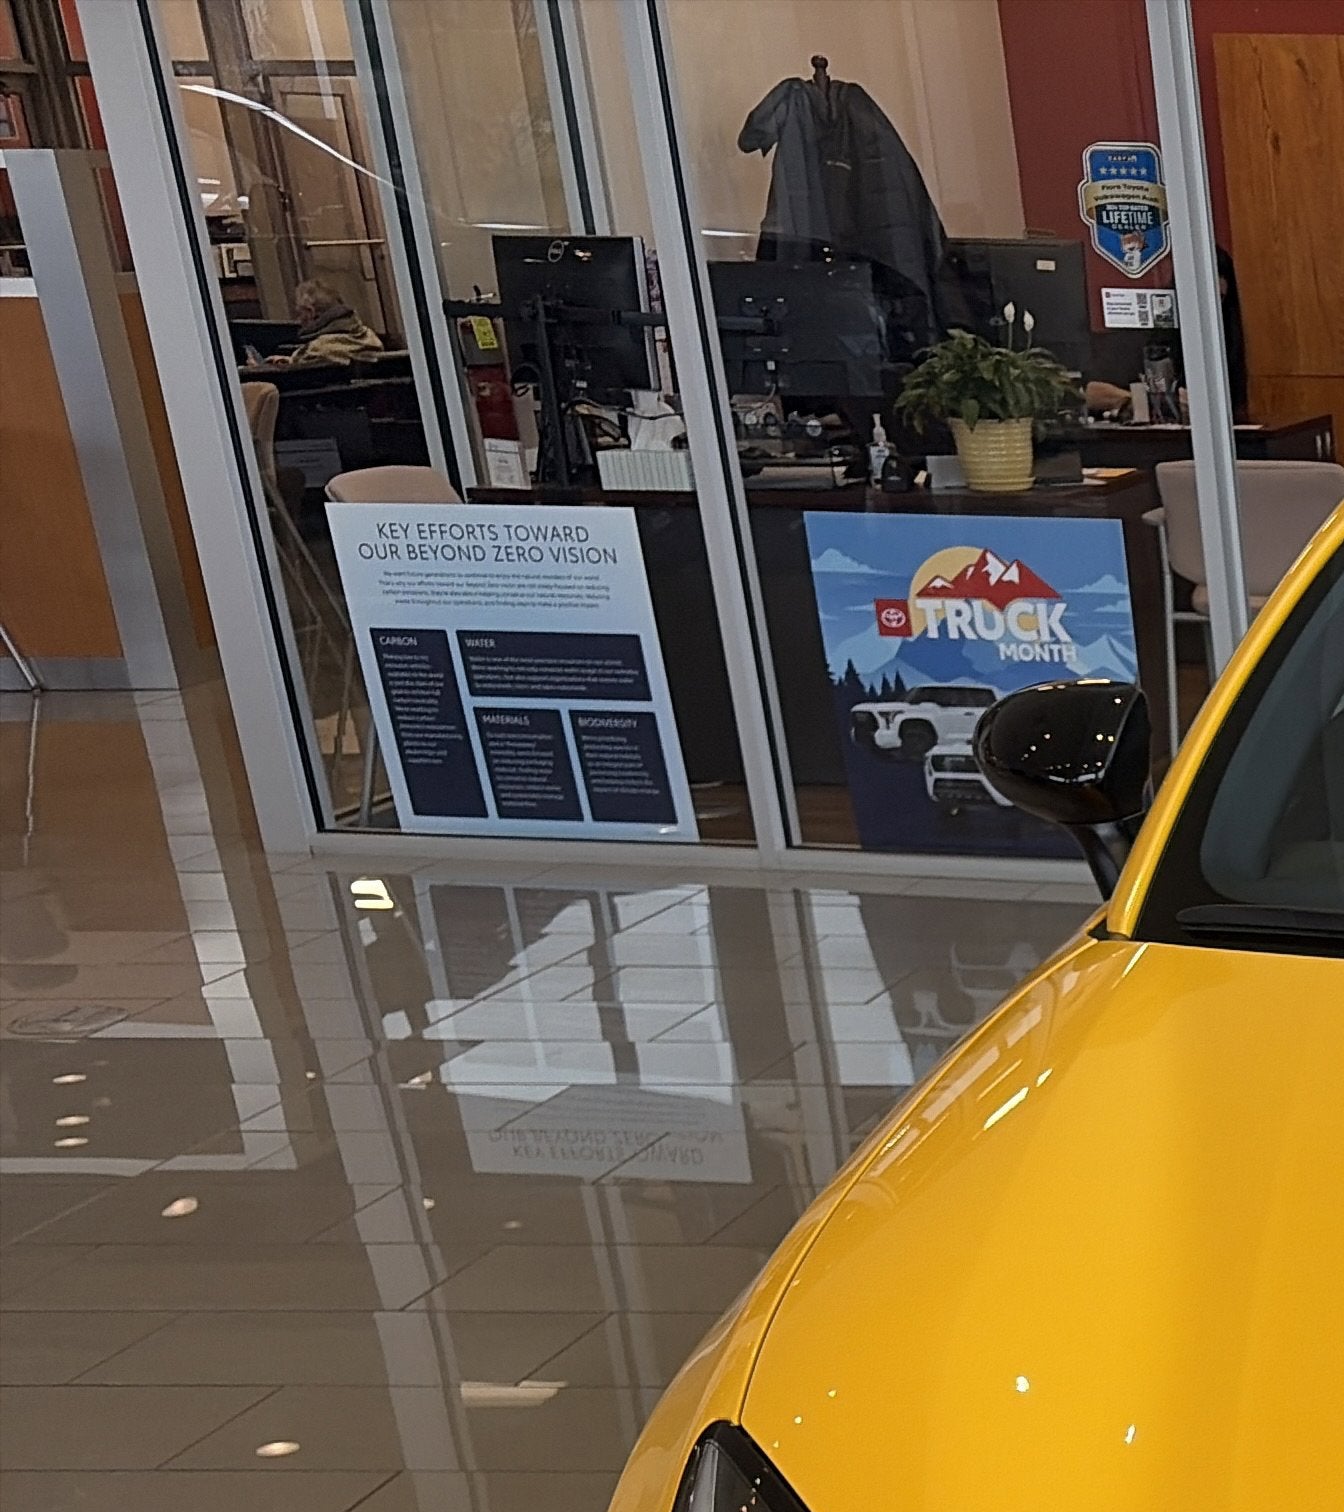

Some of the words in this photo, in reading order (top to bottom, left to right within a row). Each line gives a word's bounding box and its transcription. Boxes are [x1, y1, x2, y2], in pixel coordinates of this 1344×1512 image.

[1102, 211, 1153, 225] LIFETIME
[376, 523, 410, 540] KEY
[417, 523, 499, 542] EFFORTS
[504, 524, 589, 543] TOWARD
[358, 543, 402, 560] OUR
[407, 543, 486, 562] BEYOND
[494, 545, 545, 563] ZERO
[549, 546, 618, 565] VISION
[916, 600, 1072, 642] TRUCK
[465, 638, 496, 649] WATER
[999, 643, 1078, 663] MONTH
[482, 715, 529, 726] MATERIALS
[578, 717, 637, 729] BIODIVERSITY
